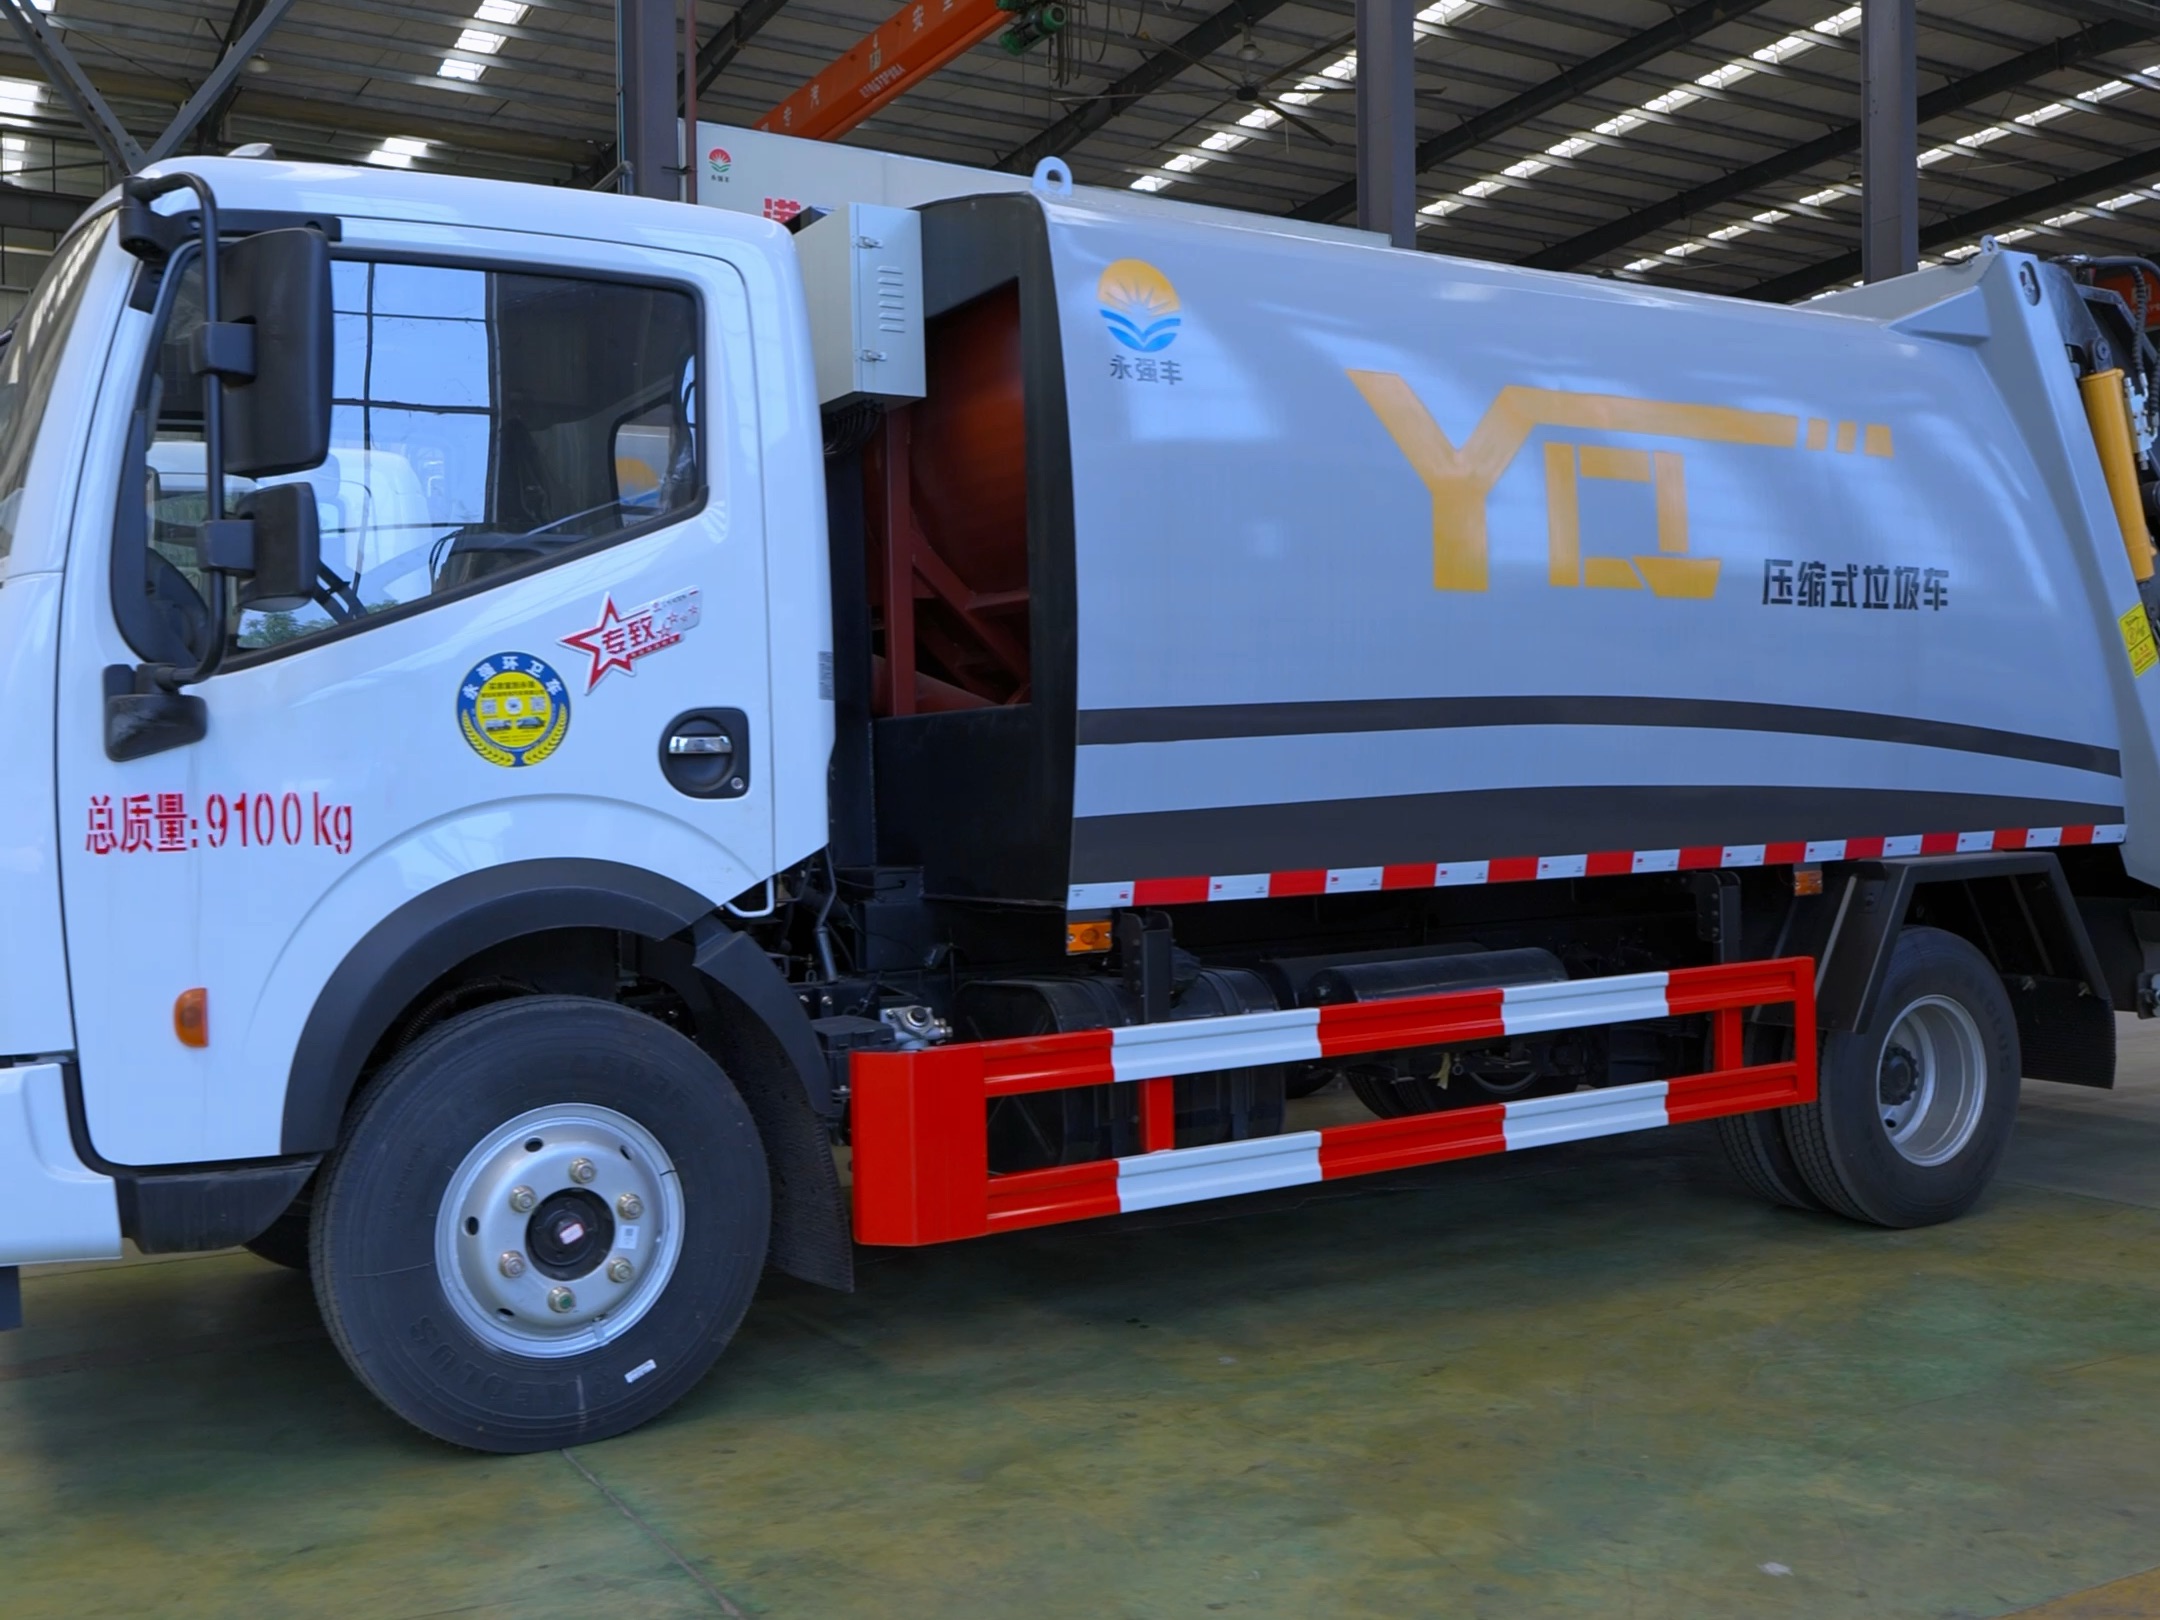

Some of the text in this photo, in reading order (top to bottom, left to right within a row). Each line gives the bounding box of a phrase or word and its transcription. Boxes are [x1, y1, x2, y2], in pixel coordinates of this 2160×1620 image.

[1110, 354, 1183, 385] 永强丰
[1762, 558, 1949, 611] 压缩式垃圾车
